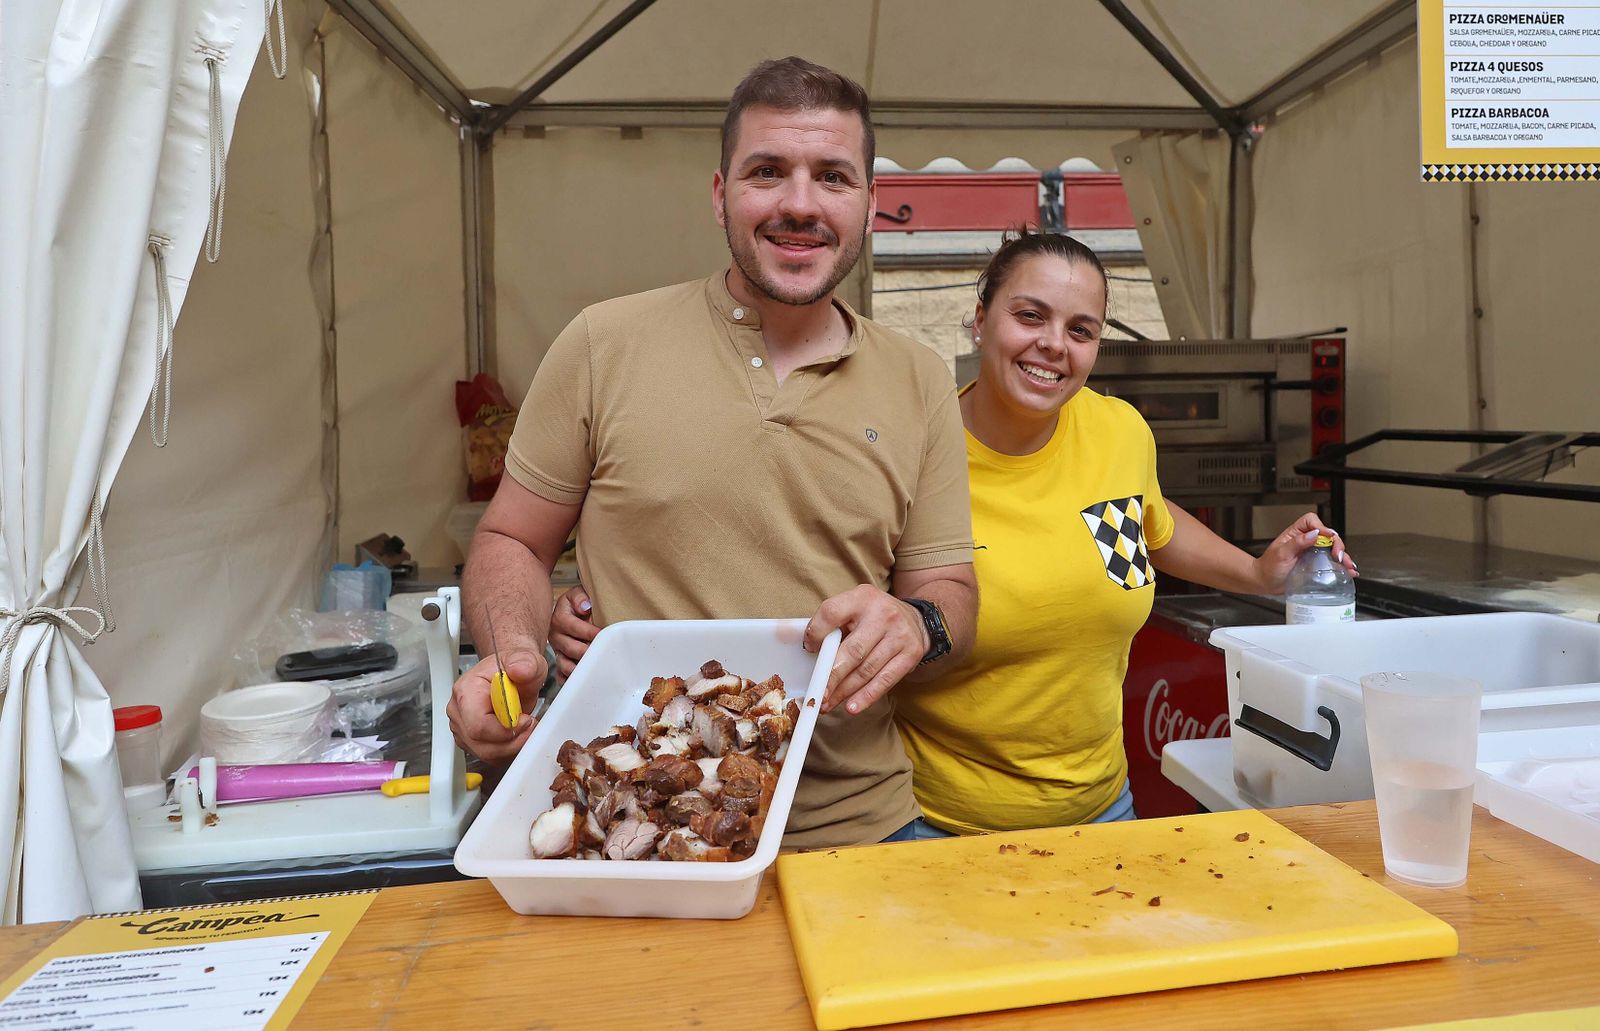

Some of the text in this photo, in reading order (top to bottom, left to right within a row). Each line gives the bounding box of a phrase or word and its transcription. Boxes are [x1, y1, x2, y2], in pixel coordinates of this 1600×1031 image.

[1449, 13, 1485, 25] PIZZA
[1450, 61, 1544, 74] PIZZA 4 QUESOS
[1451, 107, 1549, 119] PIZZA BARBACOA
[1570, 122, 1597, 130] PICADA,
[120, 911, 320, 935] Campea
